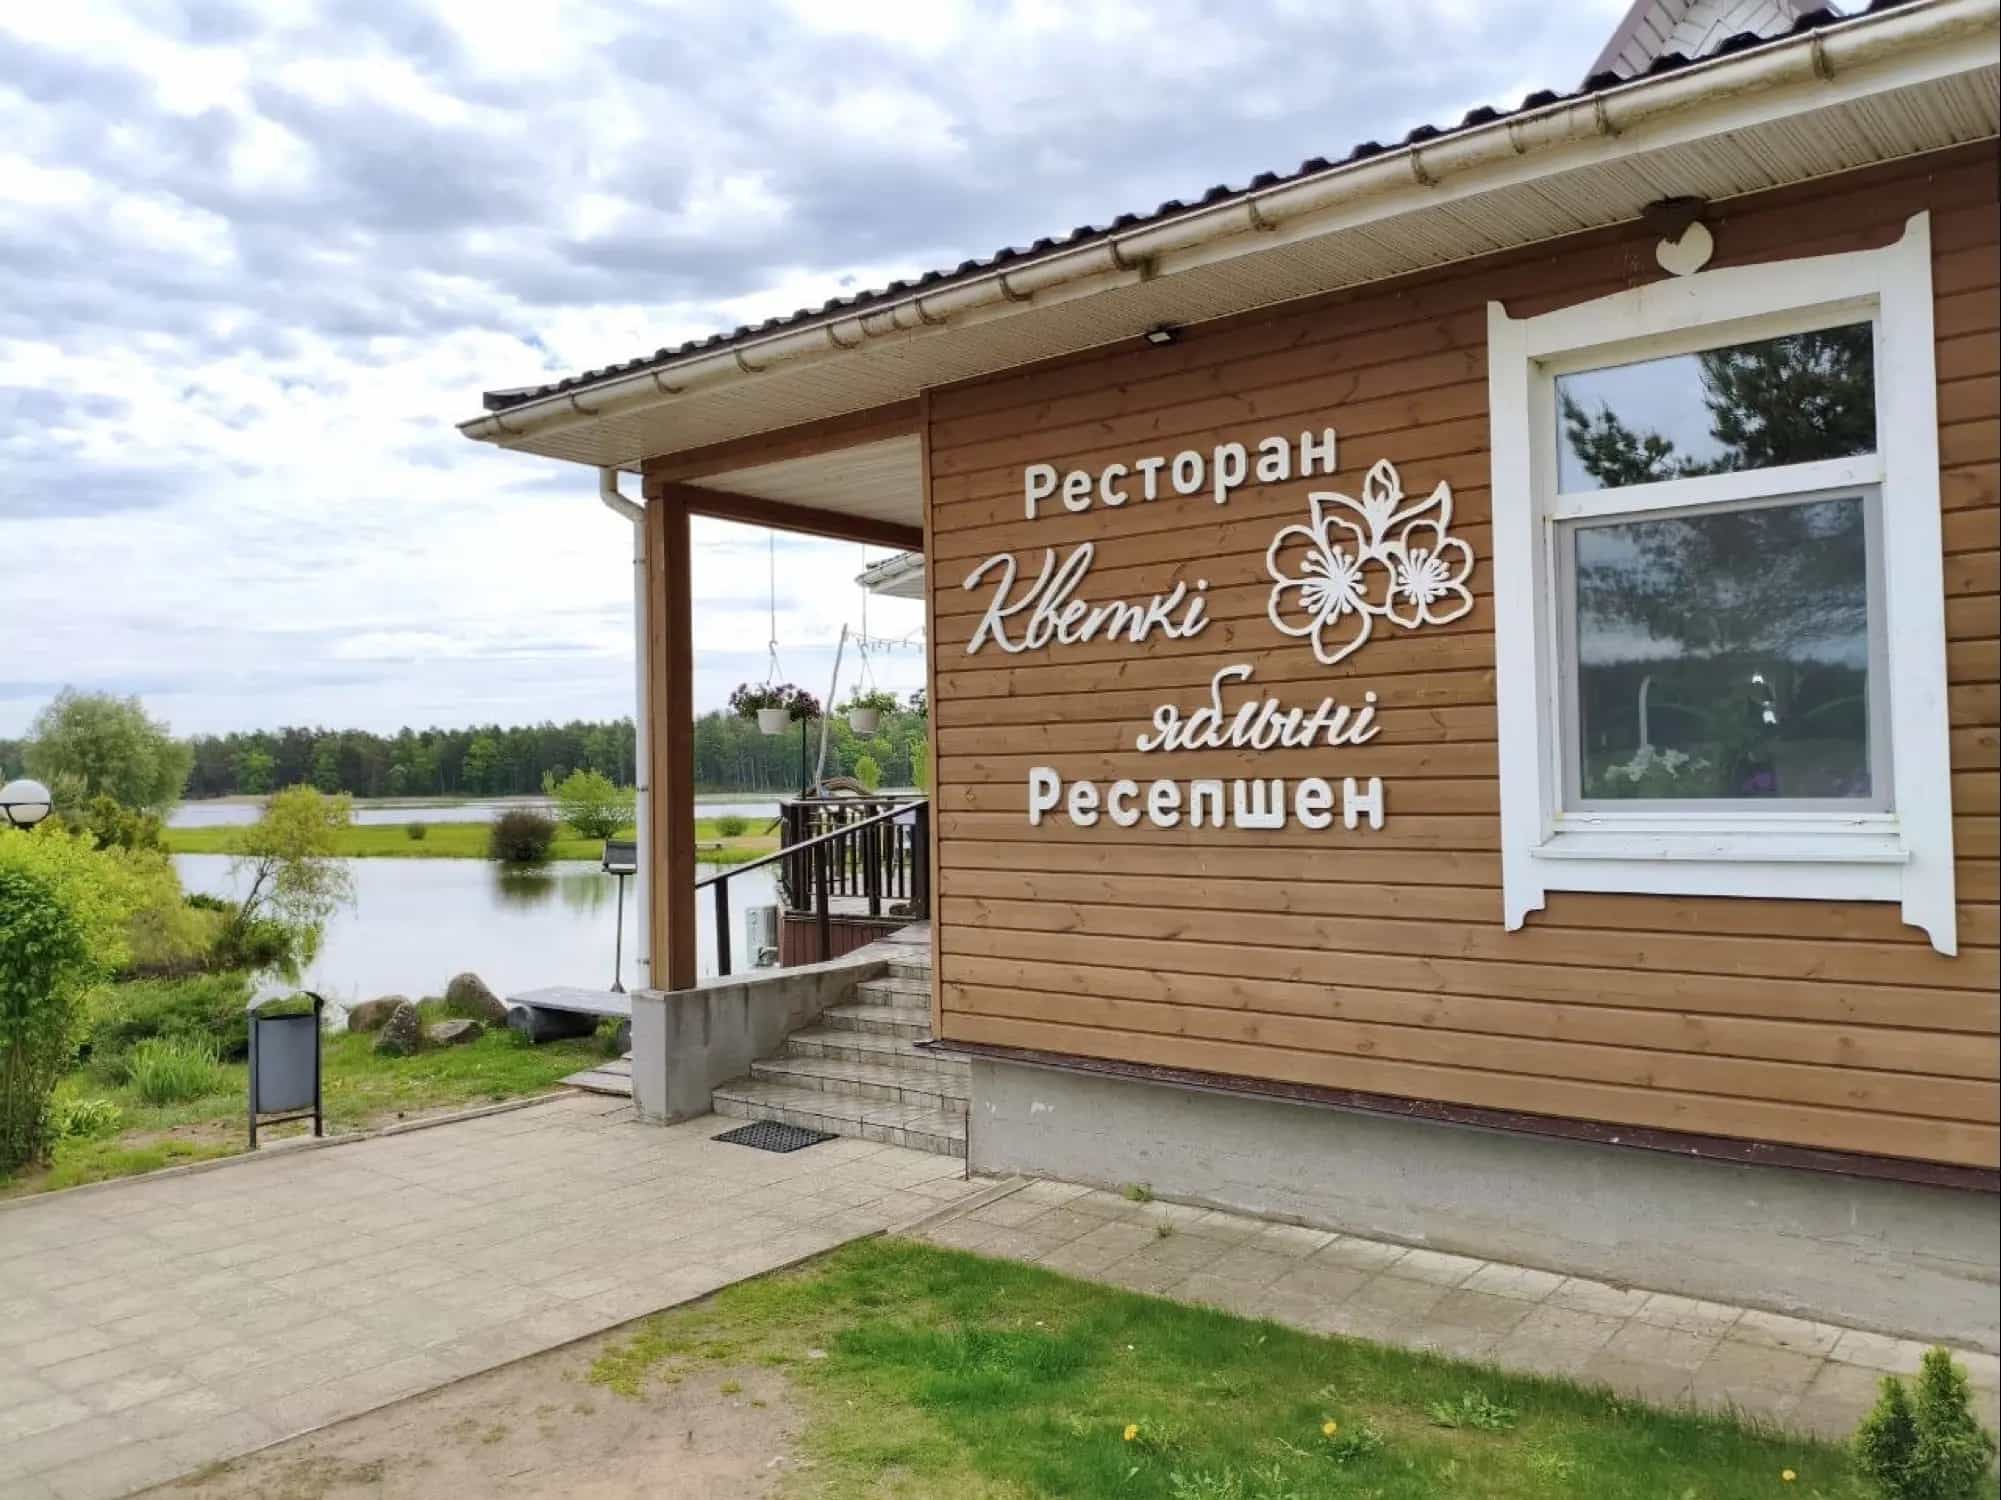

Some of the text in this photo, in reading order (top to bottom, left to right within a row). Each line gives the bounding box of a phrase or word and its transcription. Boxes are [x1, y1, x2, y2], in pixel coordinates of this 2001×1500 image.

[1025, 427, 1337, 519] Ресторан
[963, 542, 1210, 655] Кветкі
[1136, 664, 1382, 752] яблыні
[1028, 766, 1385, 830] Ресепшен
